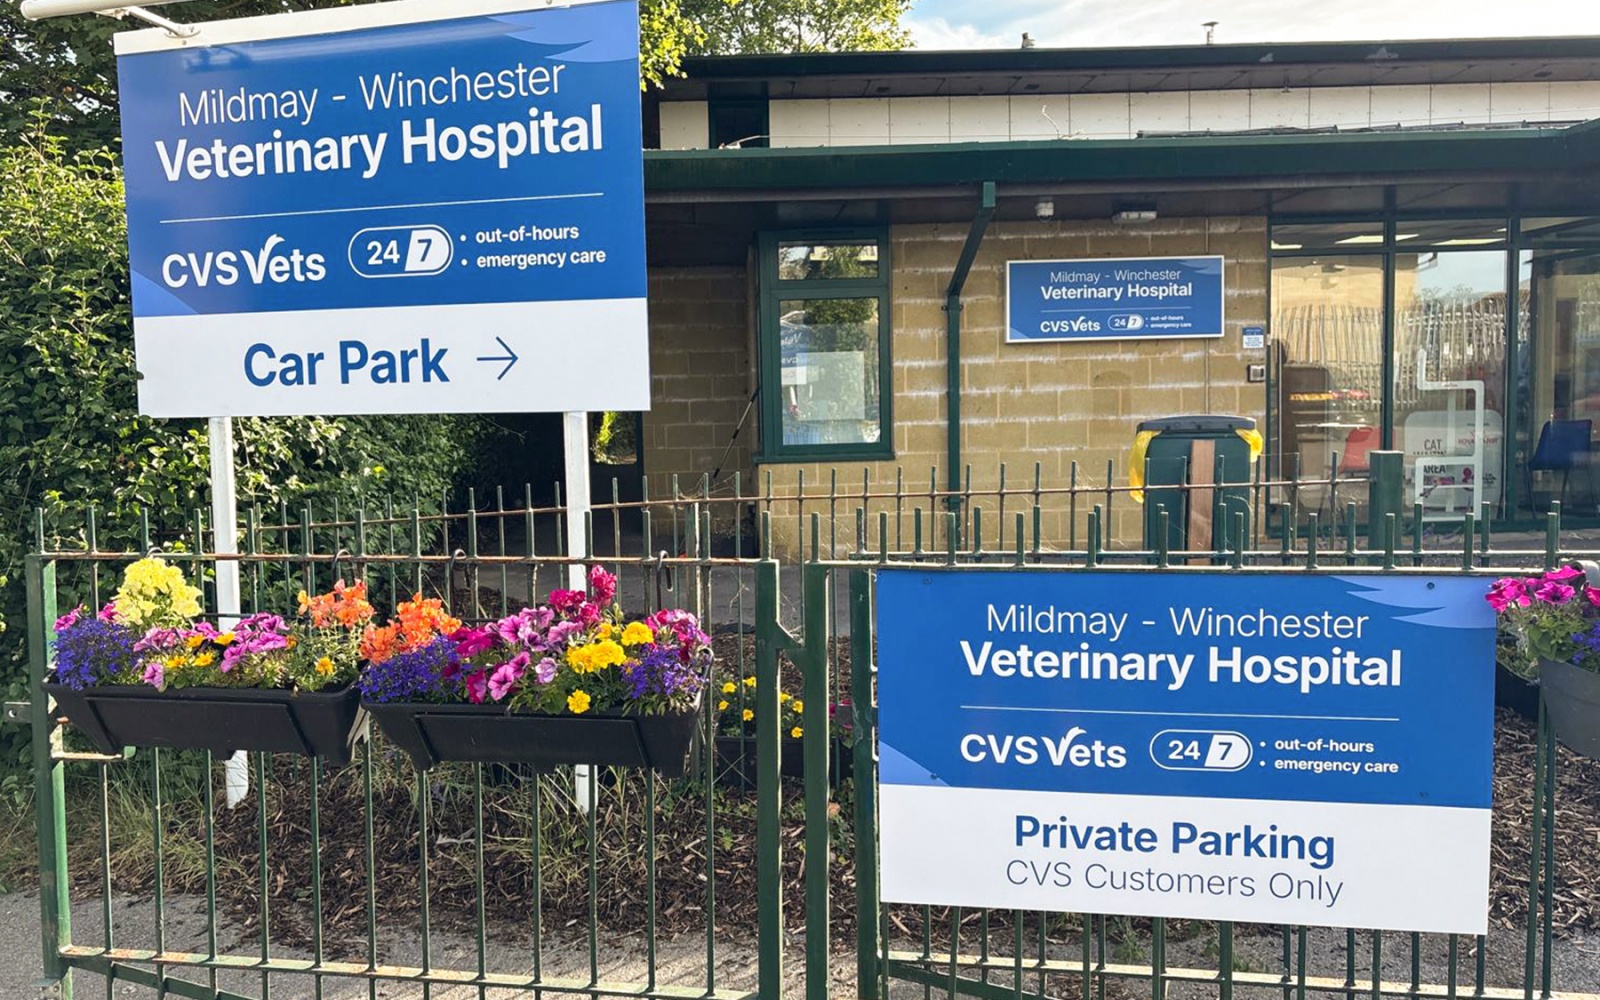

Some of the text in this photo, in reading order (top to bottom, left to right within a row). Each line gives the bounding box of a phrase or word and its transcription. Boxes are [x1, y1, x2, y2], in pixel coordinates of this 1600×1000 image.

[179, 86, 318, 126] Mildmay
[358, 62, 566, 111] Winchester
[154, 103, 603, 182] Veterinary Hospital
[475, 225, 579, 244] out-of-hours
[162, 233, 326, 288] CVS Vets
[367, 238, 433, 265] 24 7
[476, 248, 606, 271] emergency care
[1050, 271, 1101, 285] Mildmay
[1114, 269, 1182, 282] Winchester
[1040, 282, 1192, 301] Veterinary Hospital
[1040, 315, 1101, 333] CVS Vets
[1114, 318, 1126, 327] 24
[244, 337, 450, 387] Car Park
[1424, 439, 1442, 451] CAT
[1423, 464, 1446, 474] AREA
[984, 603, 1128, 641] Mildmay
[1169, 607, 1370, 640] Winchester
[960, 640, 1402, 694] Veterinary Hospital
[960, 726, 1127, 769] CVS Vets
[1168, 739, 1233, 761] 24 7
[1274, 738, 1375, 753] out-of-hours
[1274, 757, 1399, 775] emergency care
[1015, 815, 1335, 869] Private Parking
[1006, 859, 1344, 908] CVS Customers Only
